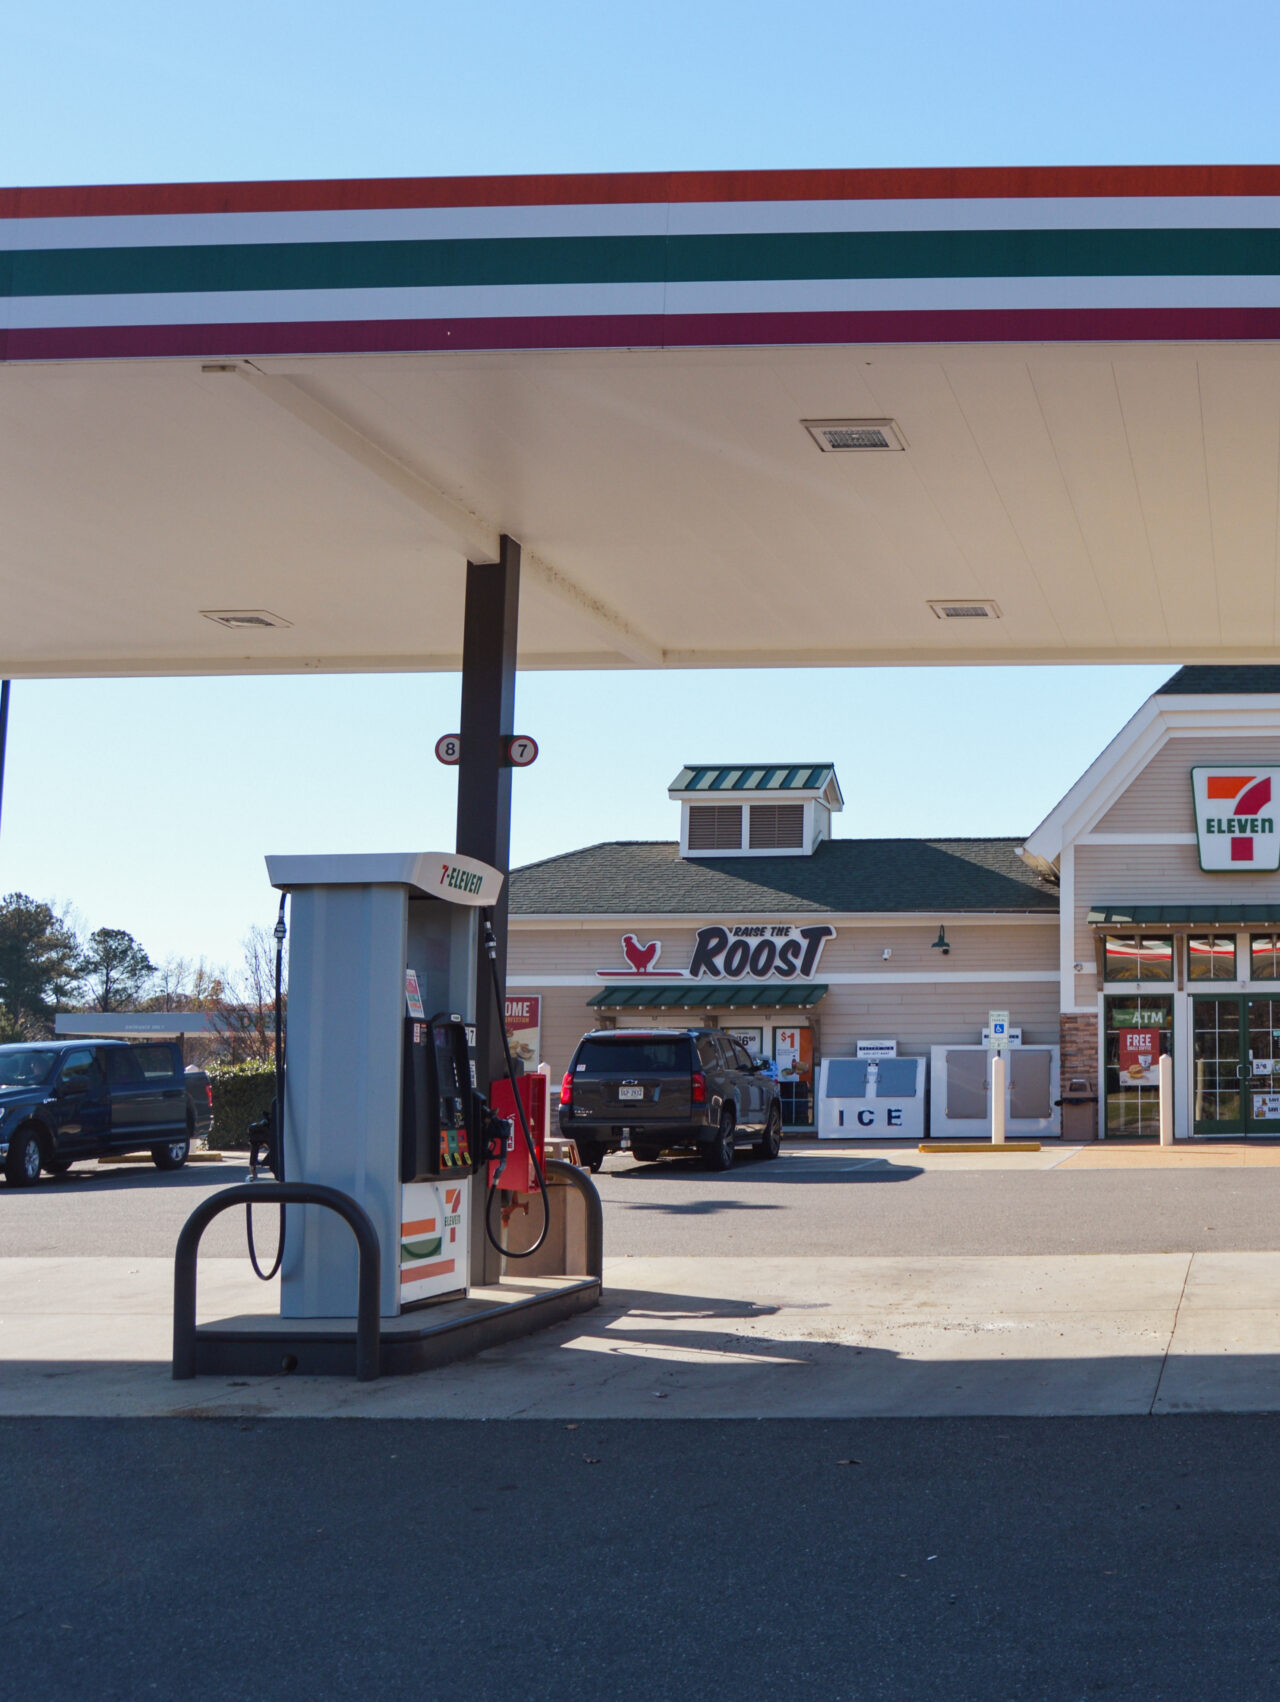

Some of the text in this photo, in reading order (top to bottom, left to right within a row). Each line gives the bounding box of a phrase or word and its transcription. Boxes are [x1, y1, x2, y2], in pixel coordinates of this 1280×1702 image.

[445, 742, 456, 756] 8
[518, 744, 528, 758] 7
[733, 926, 792, 936] RAISE THE
[689, 926, 832, 978] ROOST
[1132, 1011, 1163, 1024] ATM
[781, 1032, 795, 1048] $1
[1127, 1034, 1152, 1046] FREE
[839, 1108, 902, 1126] ICE
